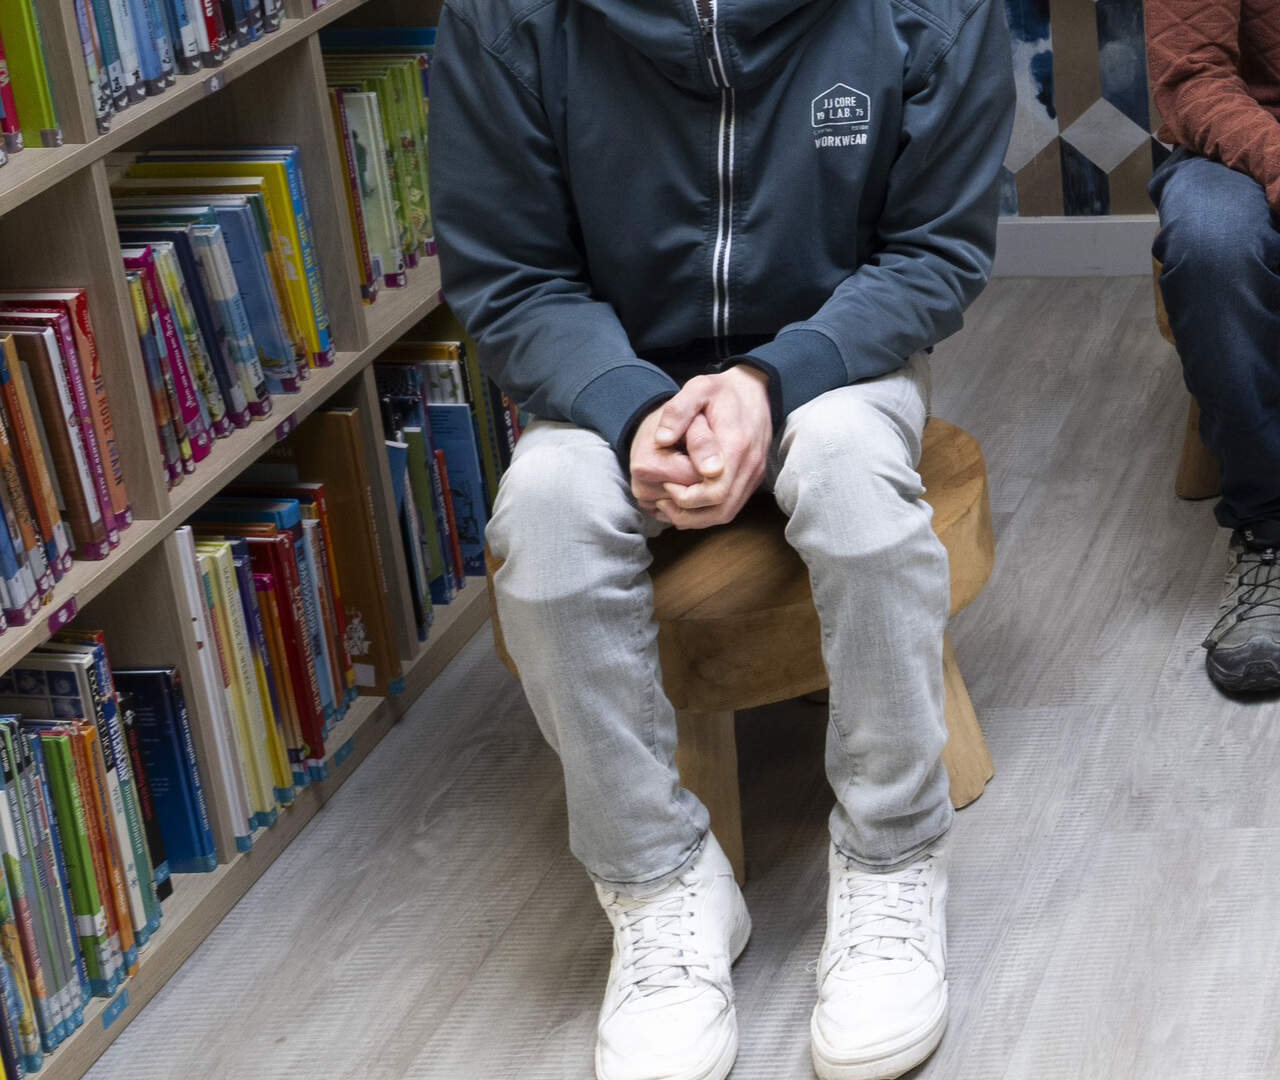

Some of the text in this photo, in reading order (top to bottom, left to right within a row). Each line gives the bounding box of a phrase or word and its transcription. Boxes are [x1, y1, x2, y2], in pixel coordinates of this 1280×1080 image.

[834, 96, 857, 108] CORE
[855, 109, 864, 117] 75
[814, 134, 868, 149] WORKWEAR
